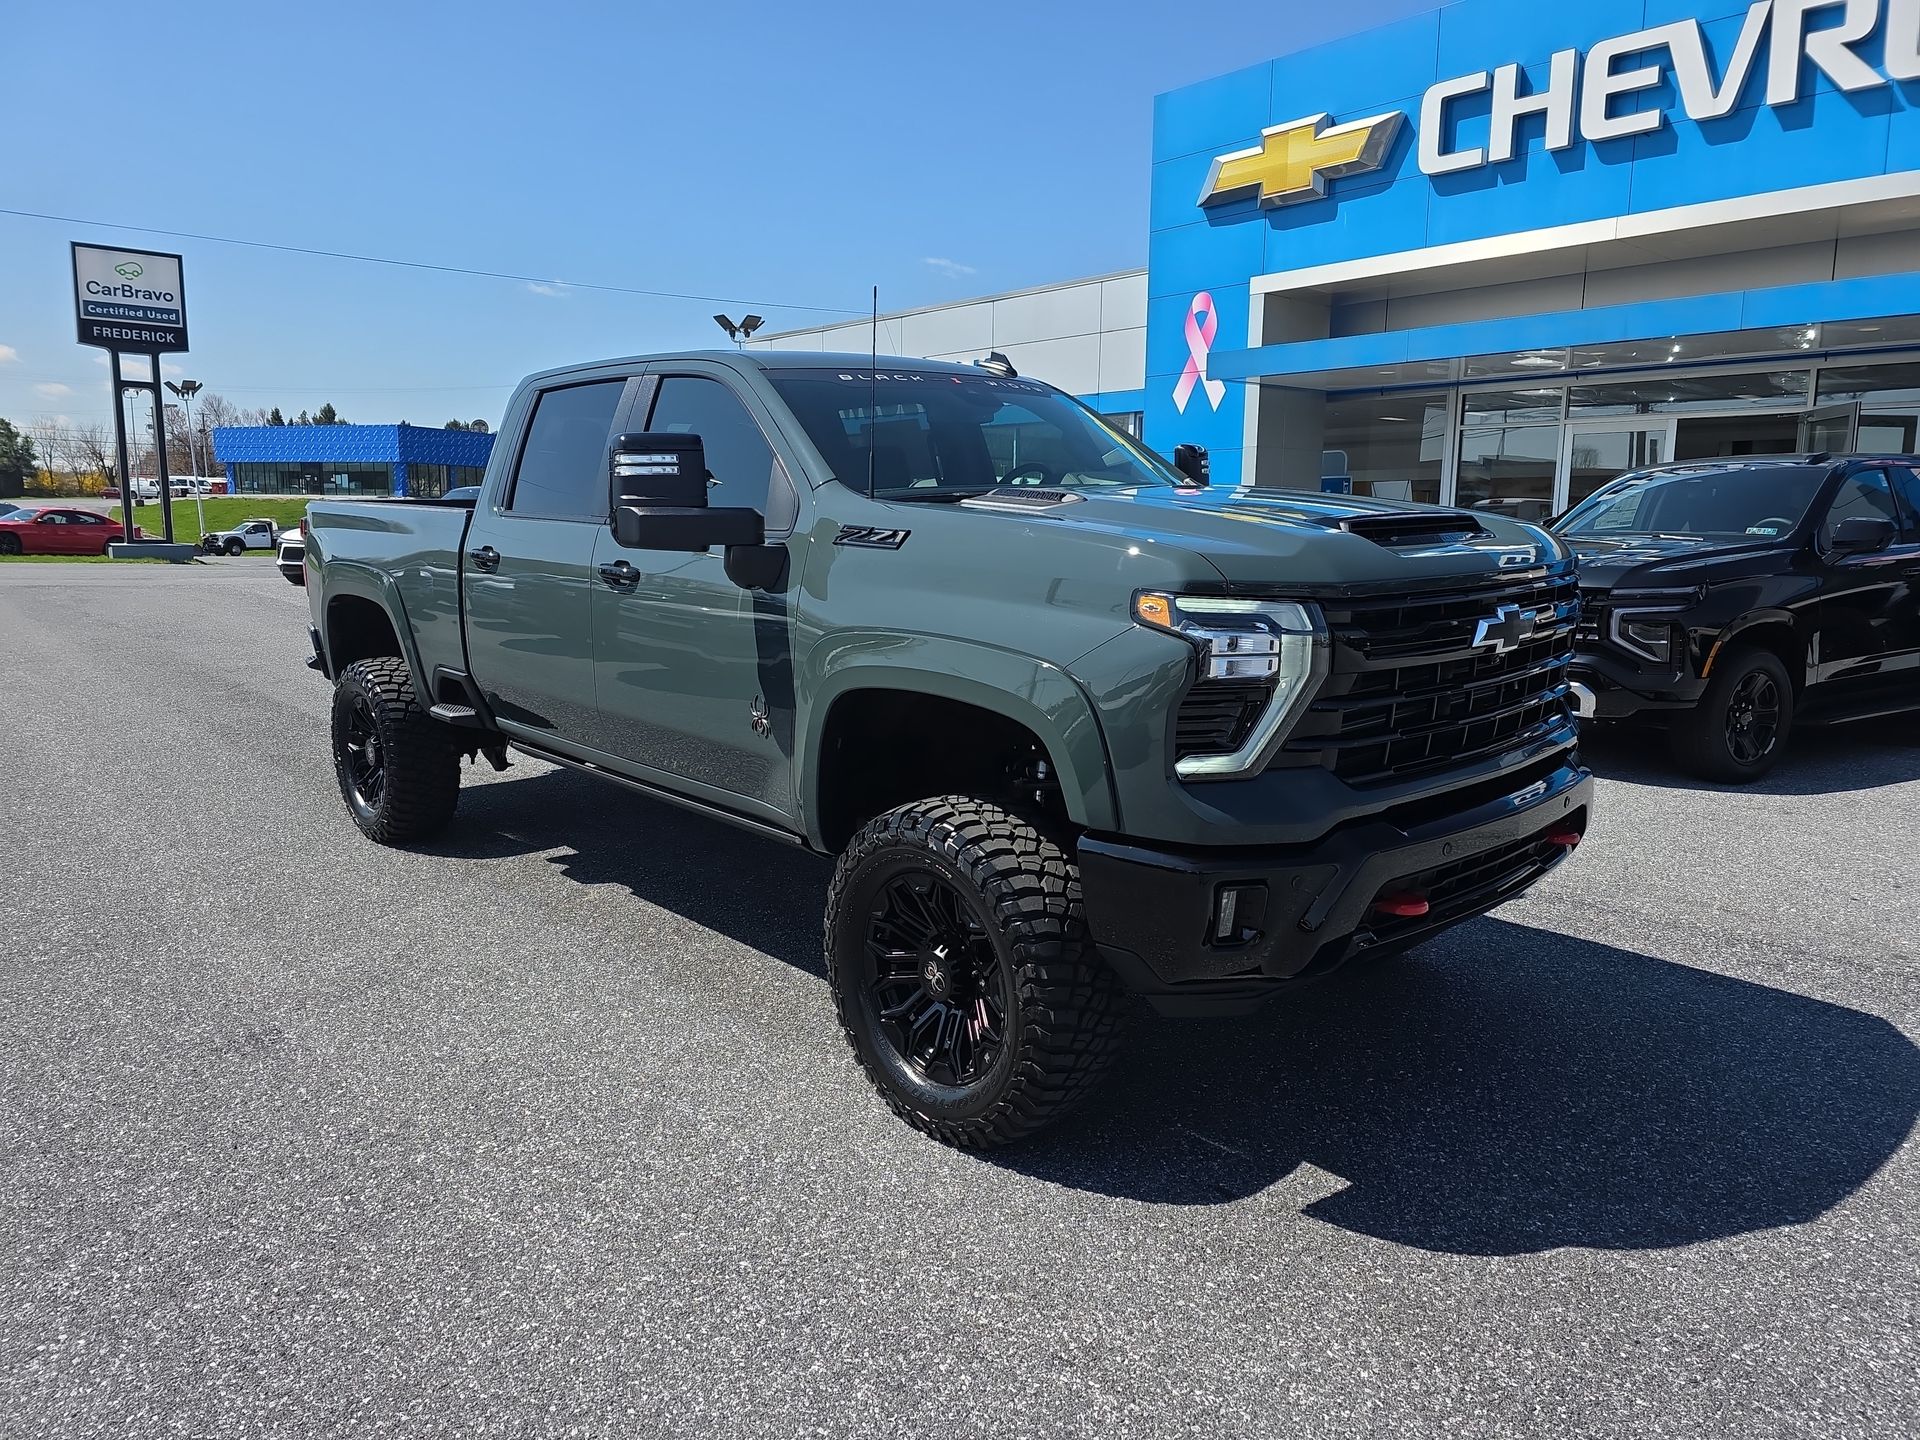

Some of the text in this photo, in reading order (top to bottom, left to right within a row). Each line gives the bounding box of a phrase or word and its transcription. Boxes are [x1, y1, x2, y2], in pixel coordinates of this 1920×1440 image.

[86, 280, 174, 302] CarBravo
[87, 304, 176, 321] Certified Used
[93, 326, 176, 343] FREDERICK
[838, 374, 924, 382] BLACK
